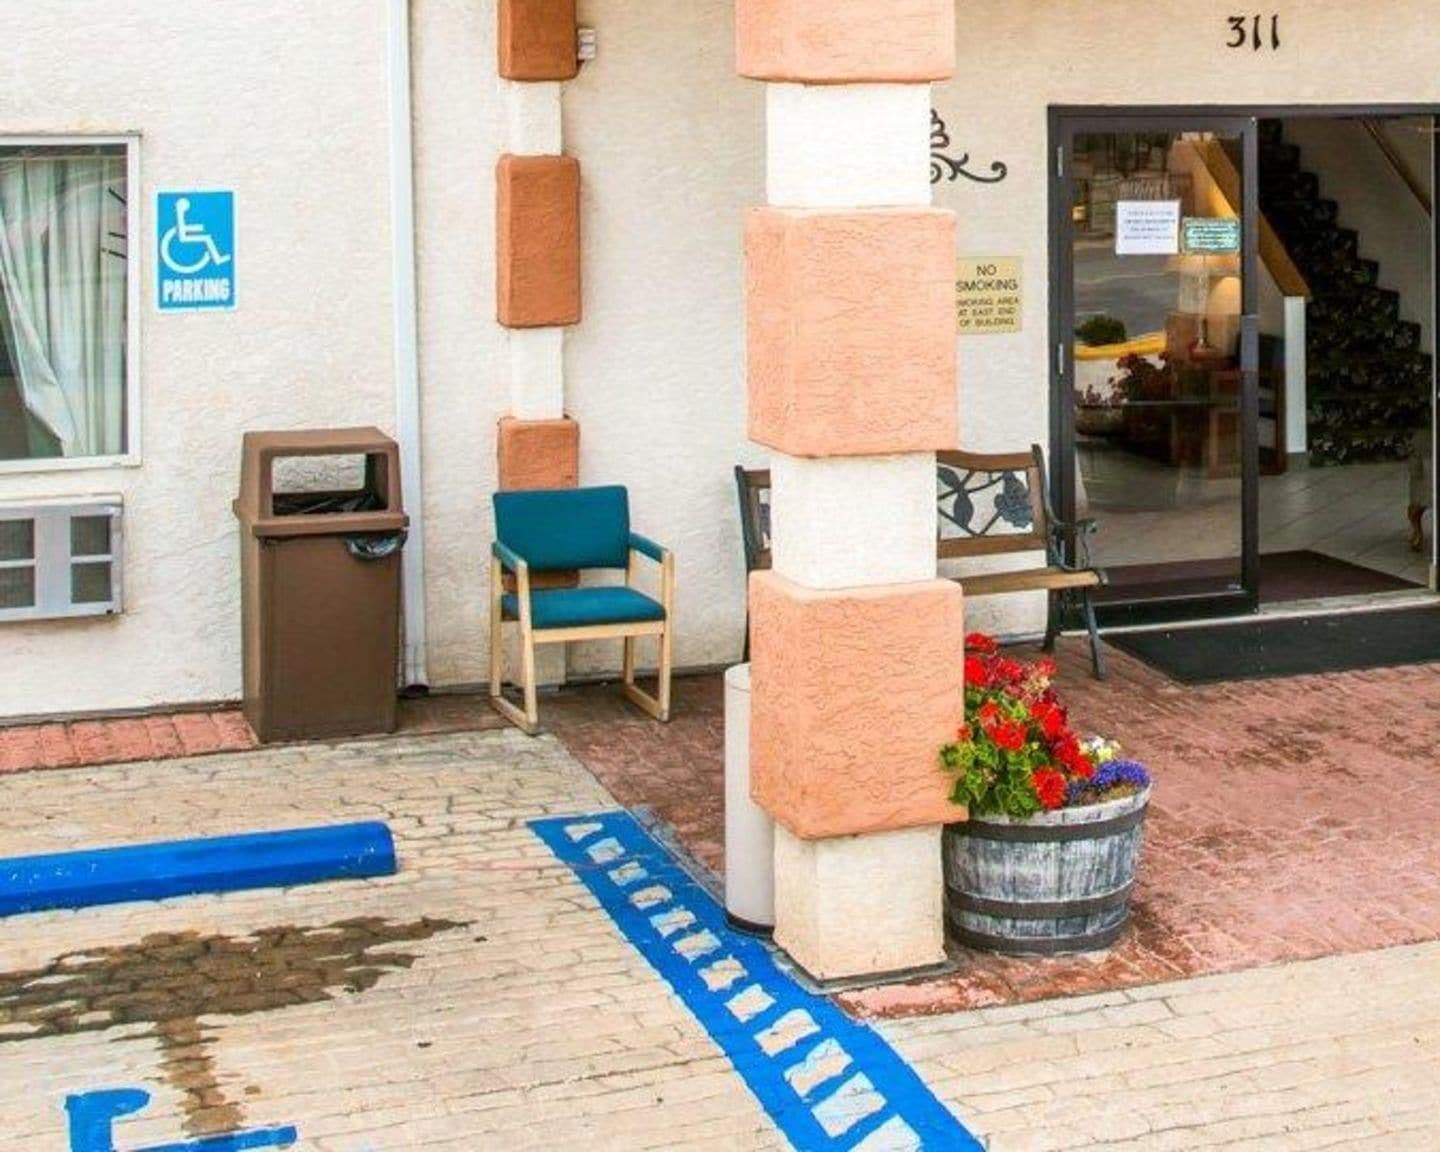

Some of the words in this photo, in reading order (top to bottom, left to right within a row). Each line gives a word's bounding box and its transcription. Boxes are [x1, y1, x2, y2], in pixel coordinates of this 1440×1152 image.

[1226, 14, 1280, 52] 311
[976, 264, 997, 276] NO
[163, 278, 230, 302] PARKING
[955, 278, 1018, 293] SMOKING
[997, 296, 1019, 305] AREA
[972, 308, 993, 317] EAST
[998, 307, 1016, 315] END
[959, 318, 970, 327] OF
[974, 317, 1014, 327] BUILDING
